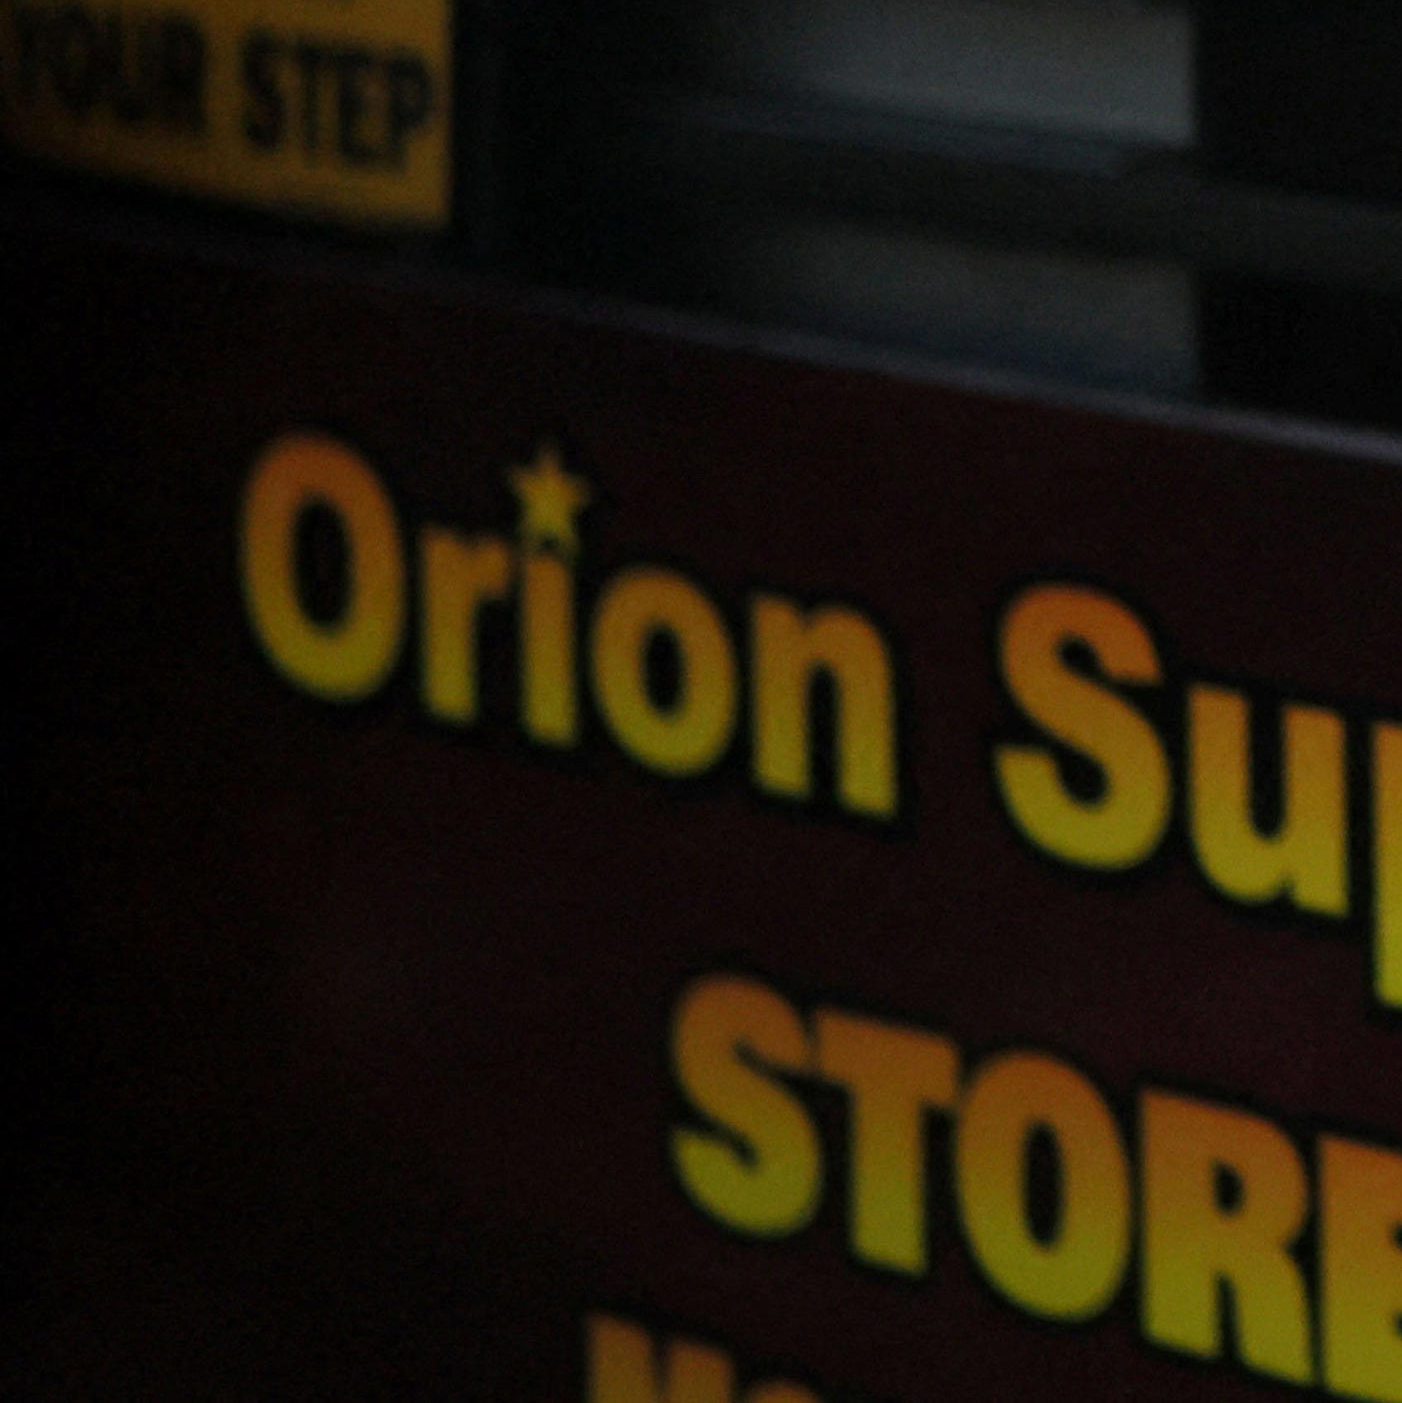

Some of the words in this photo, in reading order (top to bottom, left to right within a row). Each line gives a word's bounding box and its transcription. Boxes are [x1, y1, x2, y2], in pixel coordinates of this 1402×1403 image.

[10, 0, 206, 132] YOUR
[241, 28, 433, 172] STEP
[238, 436, 902, 822] Orion
